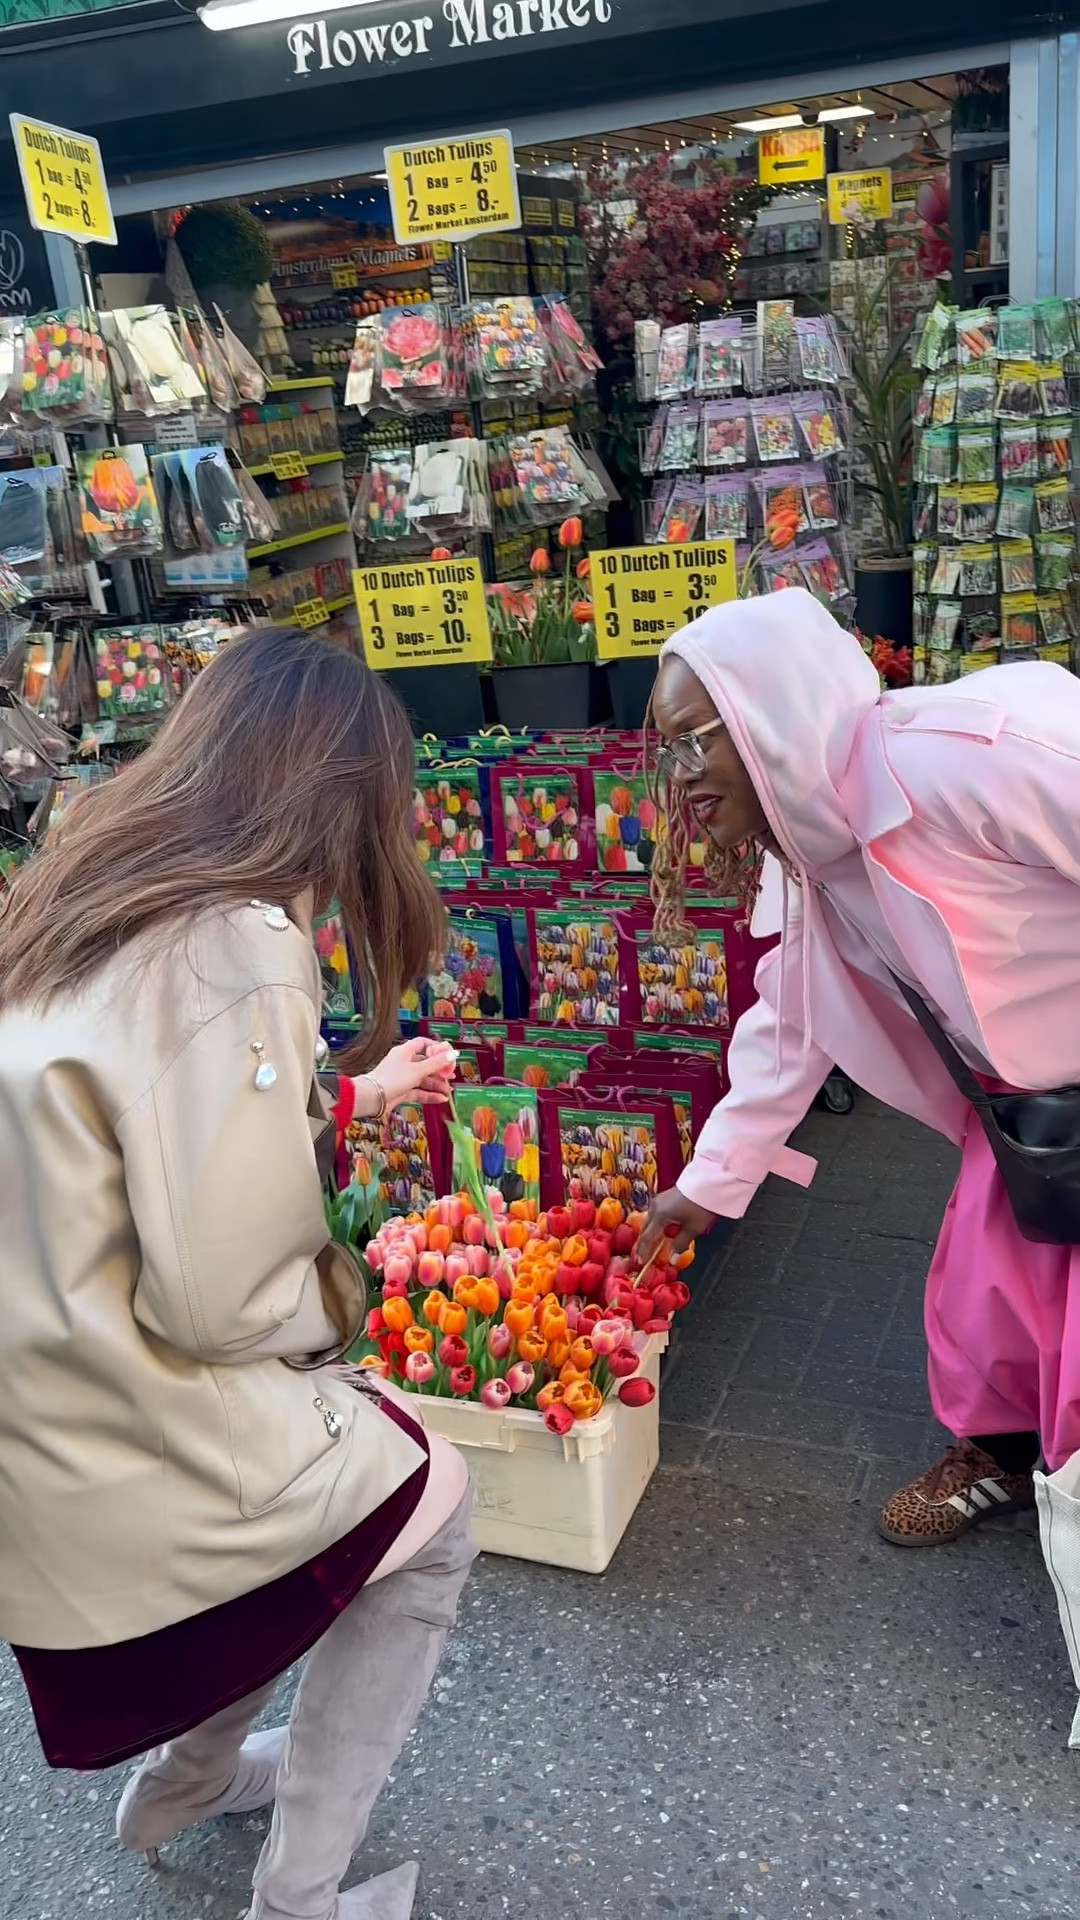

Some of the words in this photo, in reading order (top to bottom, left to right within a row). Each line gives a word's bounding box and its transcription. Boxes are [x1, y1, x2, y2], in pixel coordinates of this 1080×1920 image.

[287, 16, 434, 74] Flower
[23, 126, 58, 157] Dutch
[57, 137, 92, 164] Tulips
[403, 147, 446, 168] Dutch
[447, 141, 493, 161] Tulips
[761, 132, 820, 157] KASSA
[35, 158, 46, 186] 1
[403, 173, 415, 196] 1
[426, 177, 449, 190] Bag
[837, 175, 883, 192] Magnets
[42, 192, 55, 220] 2
[407, 199, 420, 222] 2
[427, 203, 456, 217] Bags
[408, 224, 434, 234] Flower
[435, 218, 464, 230] Market
[464, 212, 510, 226] Amsterdam
[349, 246, 418, 268] Magnets
[598, 556, 618, 575] 10
[621, 552, 670, 573] Dutch
[673, 548, 728, 568] Tulips
[361, 572, 378, 591] 10
[381, 569, 425, 590] Dutch
[427, 565, 476, 585] Tulips
[605, 583, 617, 609] 1
[631, 588, 656, 604] Bag
[368, 598, 380, 622] 1
[392, 604, 415, 618] Bag
[371, 625, 386, 650] 3
[396, 632, 425, 646] Bags
[605, 612, 620, 638] 3
[633, 619, 665, 633] Bags
